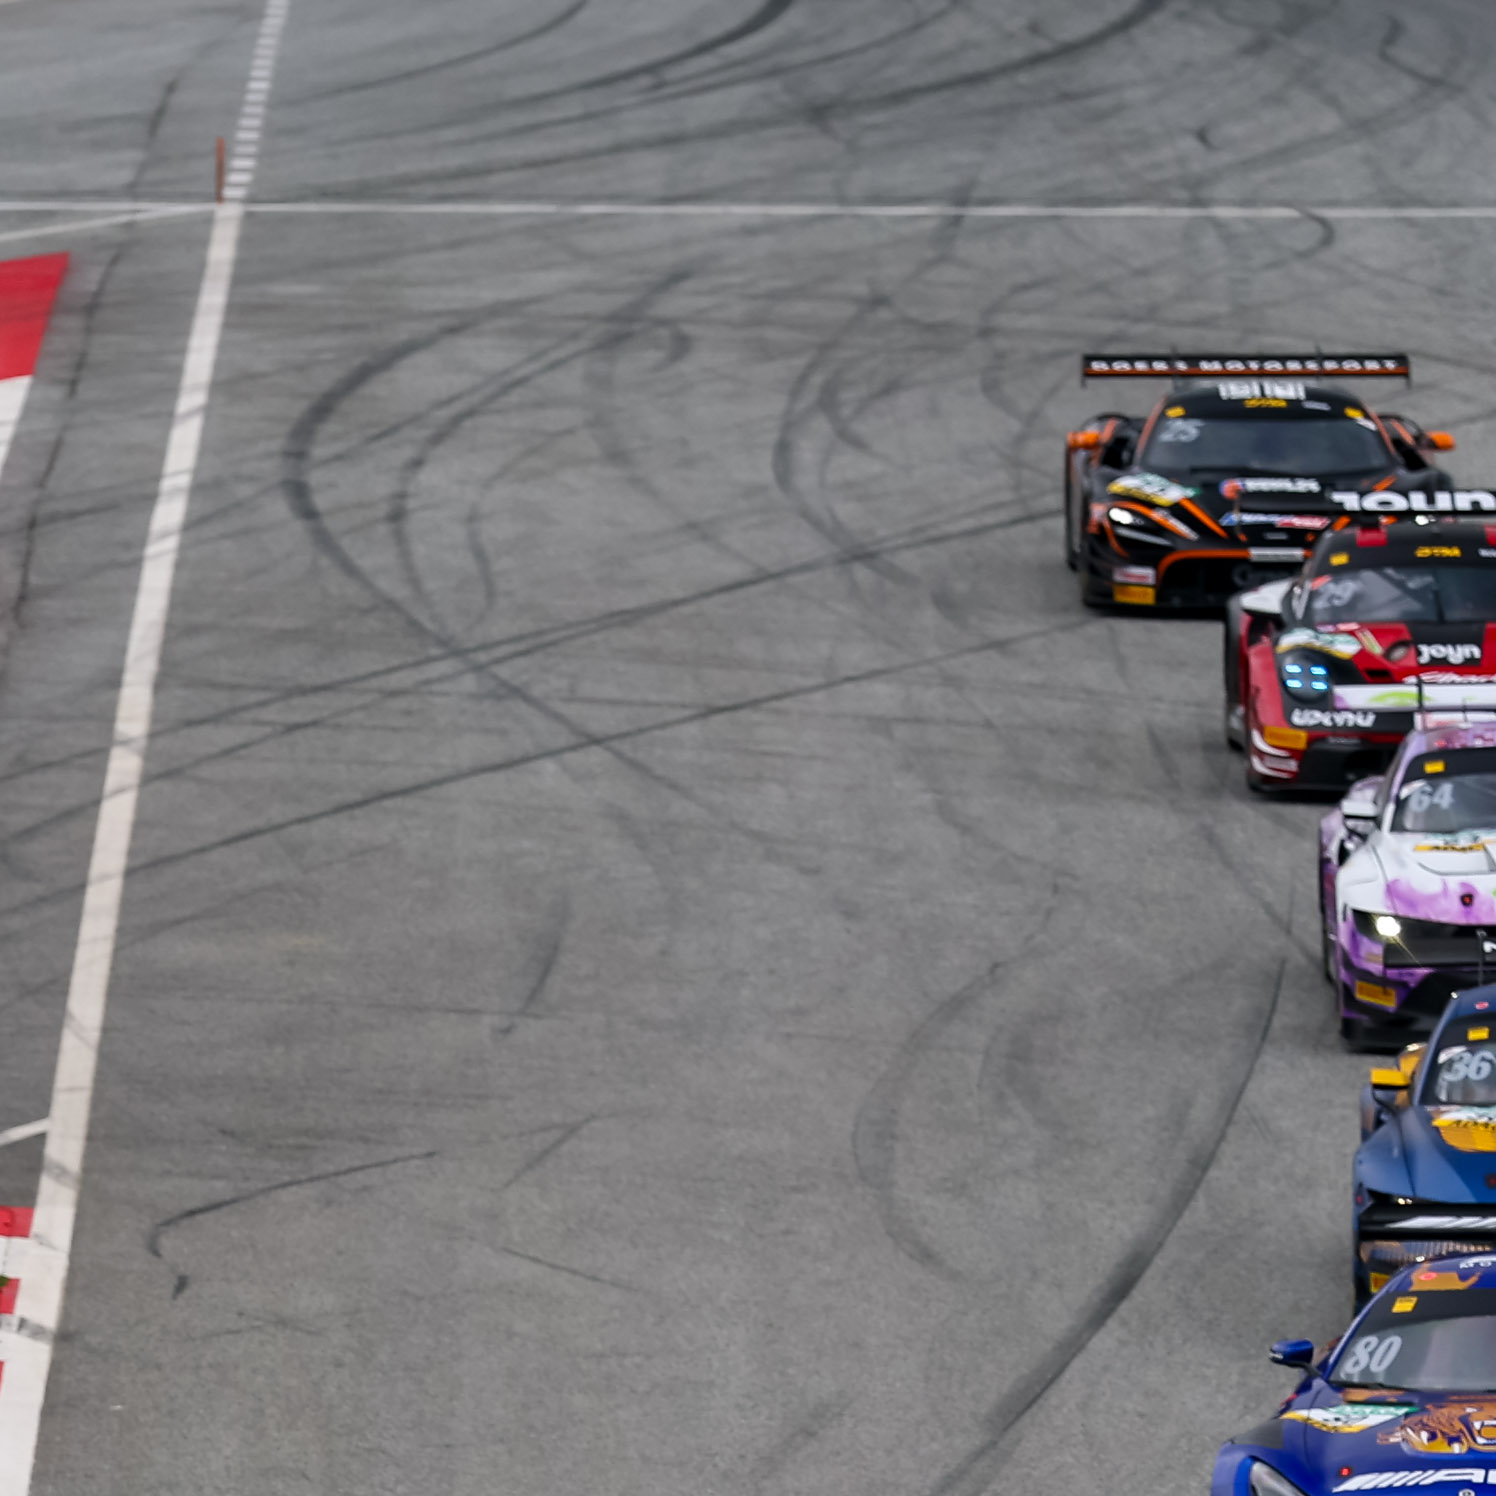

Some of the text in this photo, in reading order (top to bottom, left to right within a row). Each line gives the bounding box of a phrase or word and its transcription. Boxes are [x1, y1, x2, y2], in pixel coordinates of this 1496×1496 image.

[1199, 359, 1399, 372] MOTORSPORT
[1417, 643, 1481, 664] joyn
[1444, 1050, 1493, 1081] 36
[1341, 1334, 1403, 1374] 80
